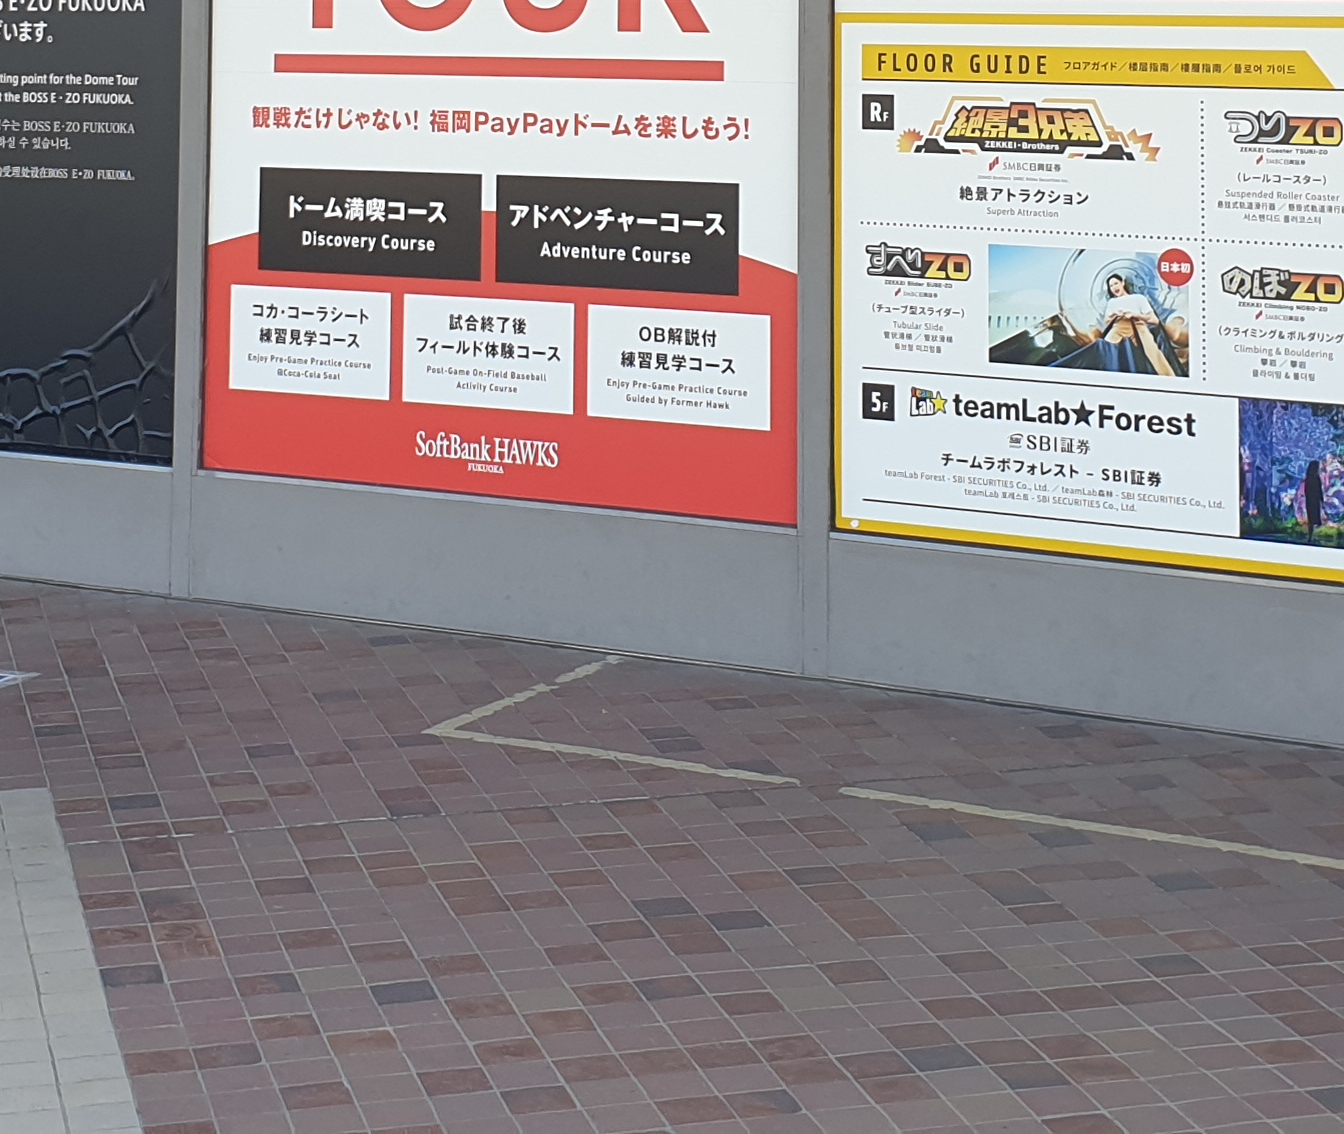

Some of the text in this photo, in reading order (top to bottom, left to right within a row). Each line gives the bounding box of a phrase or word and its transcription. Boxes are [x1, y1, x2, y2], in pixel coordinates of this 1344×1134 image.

[878, 53, 1046, 74] FLOOR GUIDE
[21, 74, 47, 86] point
[49, 73, 64, 84] for
[65, 74, 82, 84] the
[84, 74, 114, 85] Dome
[116, 75, 138, 85] Tour
[4, 92, 20, 102] the
[23, 92, 48, 103] BOSS
[83, 93, 133, 104] FUKUOKA.
[23, 121, 134, 133] BOSS FUKUOKA
[944, 102, 1103, 146] 絶景3兄弟
[960, 186, 1088, 205] 絶景アトラクション
[1225, 189, 1340, 201] Suspended Roller Coaster
[289, 196, 446, 223] ドーム満喫コース
[987, 207, 1058, 217] Superb Attraction
[510, 205, 725, 235] アドベンチャーコース
[302, 231, 435, 251] Discovery Course
[540, 242, 690, 264] Adventure Course
[1161, 262, 1190, 273] 日本初
[253, 304, 368, 324] コカ・コーラシート
[449, 314, 526, 334] 試合終了後
[893, 321, 943, 331] Tubular Slide
[260, 328, 359, 347] 練習見学コース
[639, 327, 716, 347] OB解説付
[417, 338, 560, 361] フィールド体験コース
[1234, 345, 1333, 361] Climbing Bouldering
[248, 353, 371, 369] Enjoy Pre-Game Practice Course
[621, 351, 735, 374] 練習見学コース
[324, 372, 340, 380] Seat
[427, 365, 546, 381] Post-Game On-Field Baseball
[456, 382, 517, 393] Activity Course
[607, 379, 747, 396] Enjoy Pre-Game Practice Course
[626, 394, 729, 409] Guided by Former Hawk
[416, 431, 559, 467] SoftBank HAWKS
[1027, 435, 1089, 454] SBI証券
[941, 454, 1161, 487] チームラボフォレスト SBI証券
